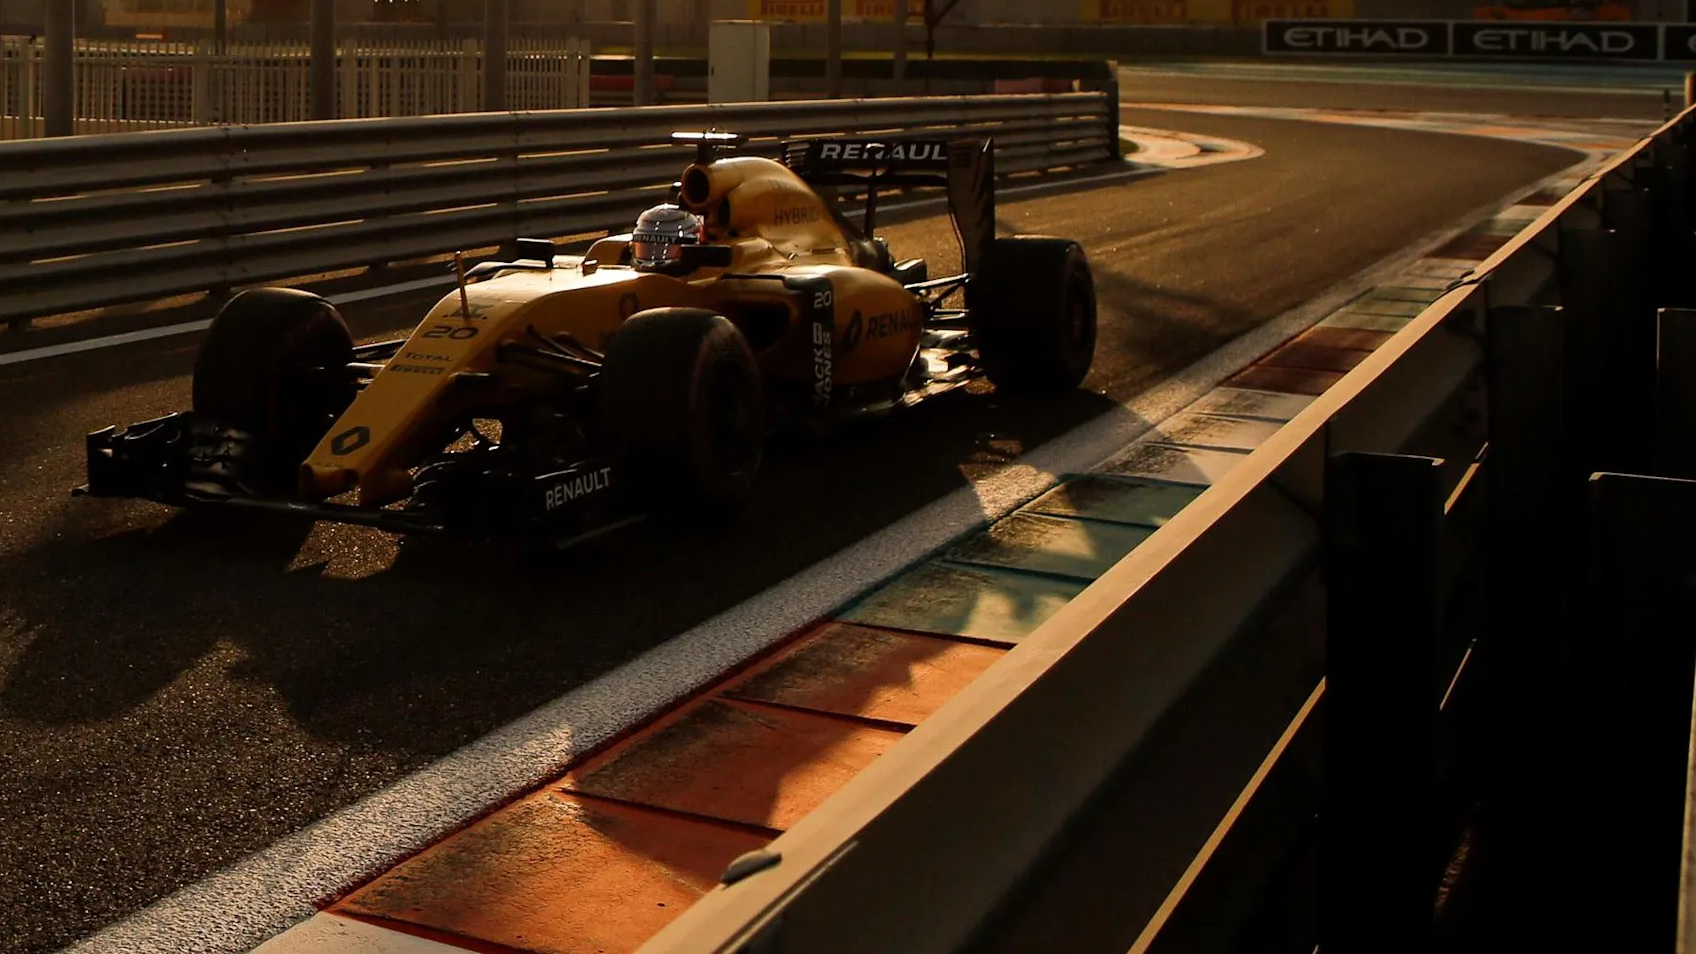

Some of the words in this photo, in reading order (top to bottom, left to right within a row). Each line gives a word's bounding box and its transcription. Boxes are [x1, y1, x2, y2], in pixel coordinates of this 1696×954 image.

[1283, 26, 1430, 51] ETIHAD
[1472, 29, 1635, 54] ETIHAD
[774, 206, 819, 227] HYBRID
[814, 290, 832, 309] 20
[421, 325, 479, 340] 20
[406, 352, 452, 362] TOTAL
[822, 330, 833, 407] JONES
[546, 467, 612, 510] RENAULT
